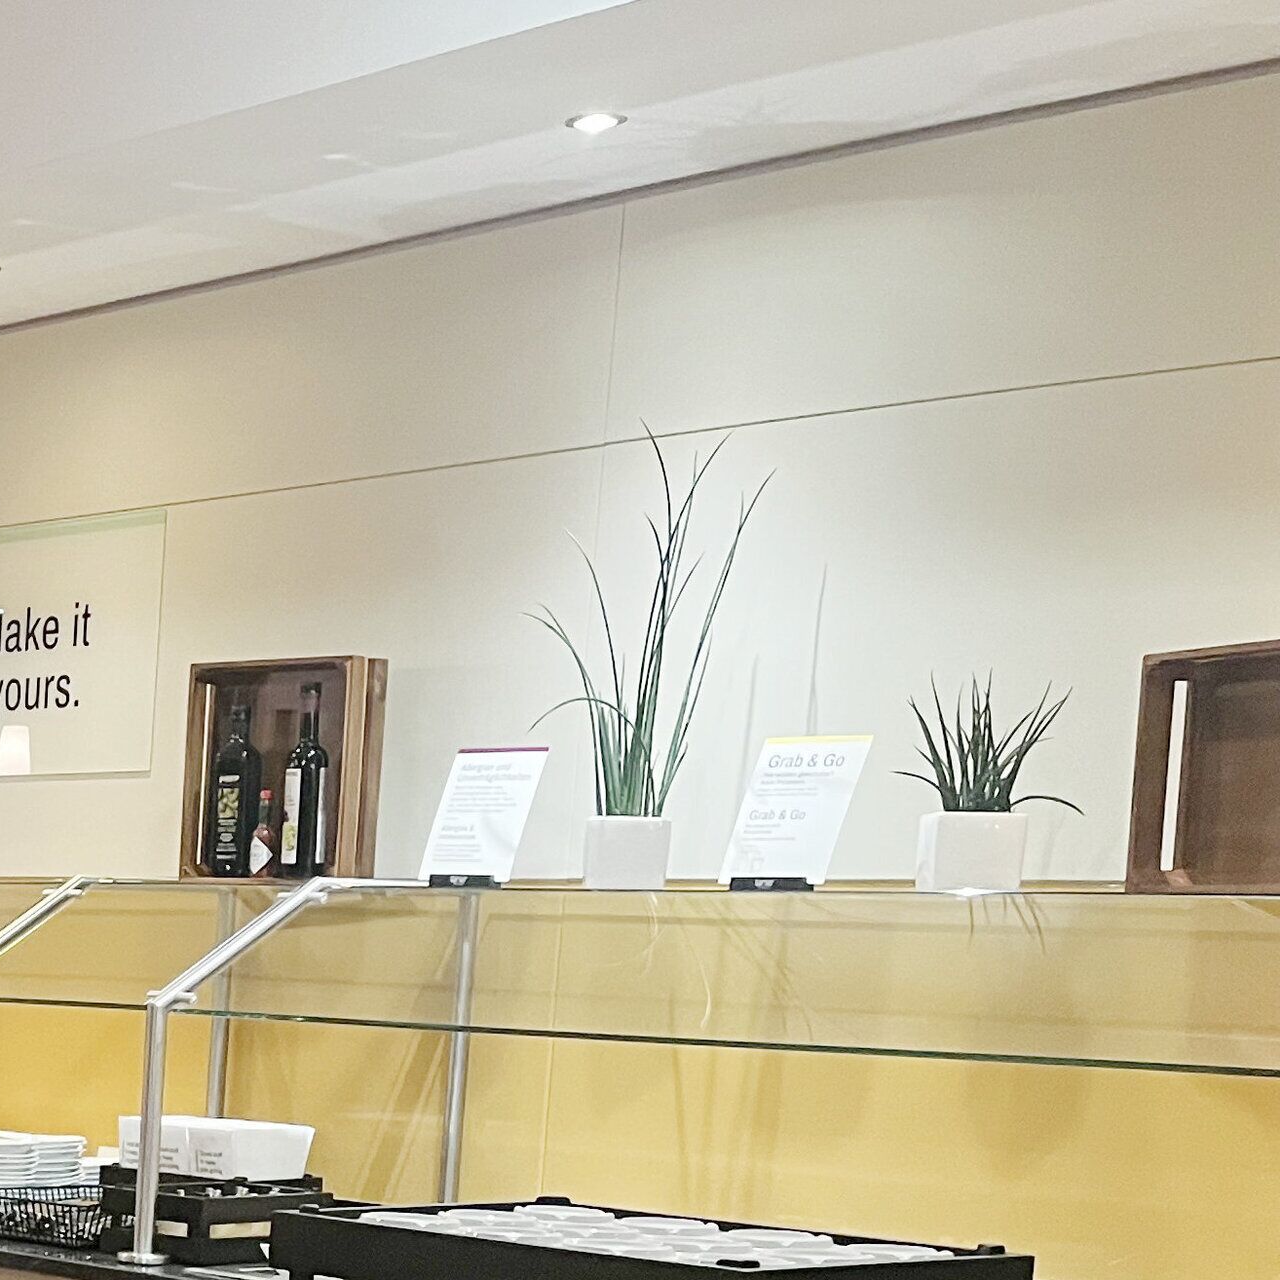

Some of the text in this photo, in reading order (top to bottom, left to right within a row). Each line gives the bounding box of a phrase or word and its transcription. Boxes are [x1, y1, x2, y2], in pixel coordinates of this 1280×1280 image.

[72, 601, 92, 647] it
[768, 753, 846, 769] Grab & Go
[749, 808, 806, 821] Grab & Go
